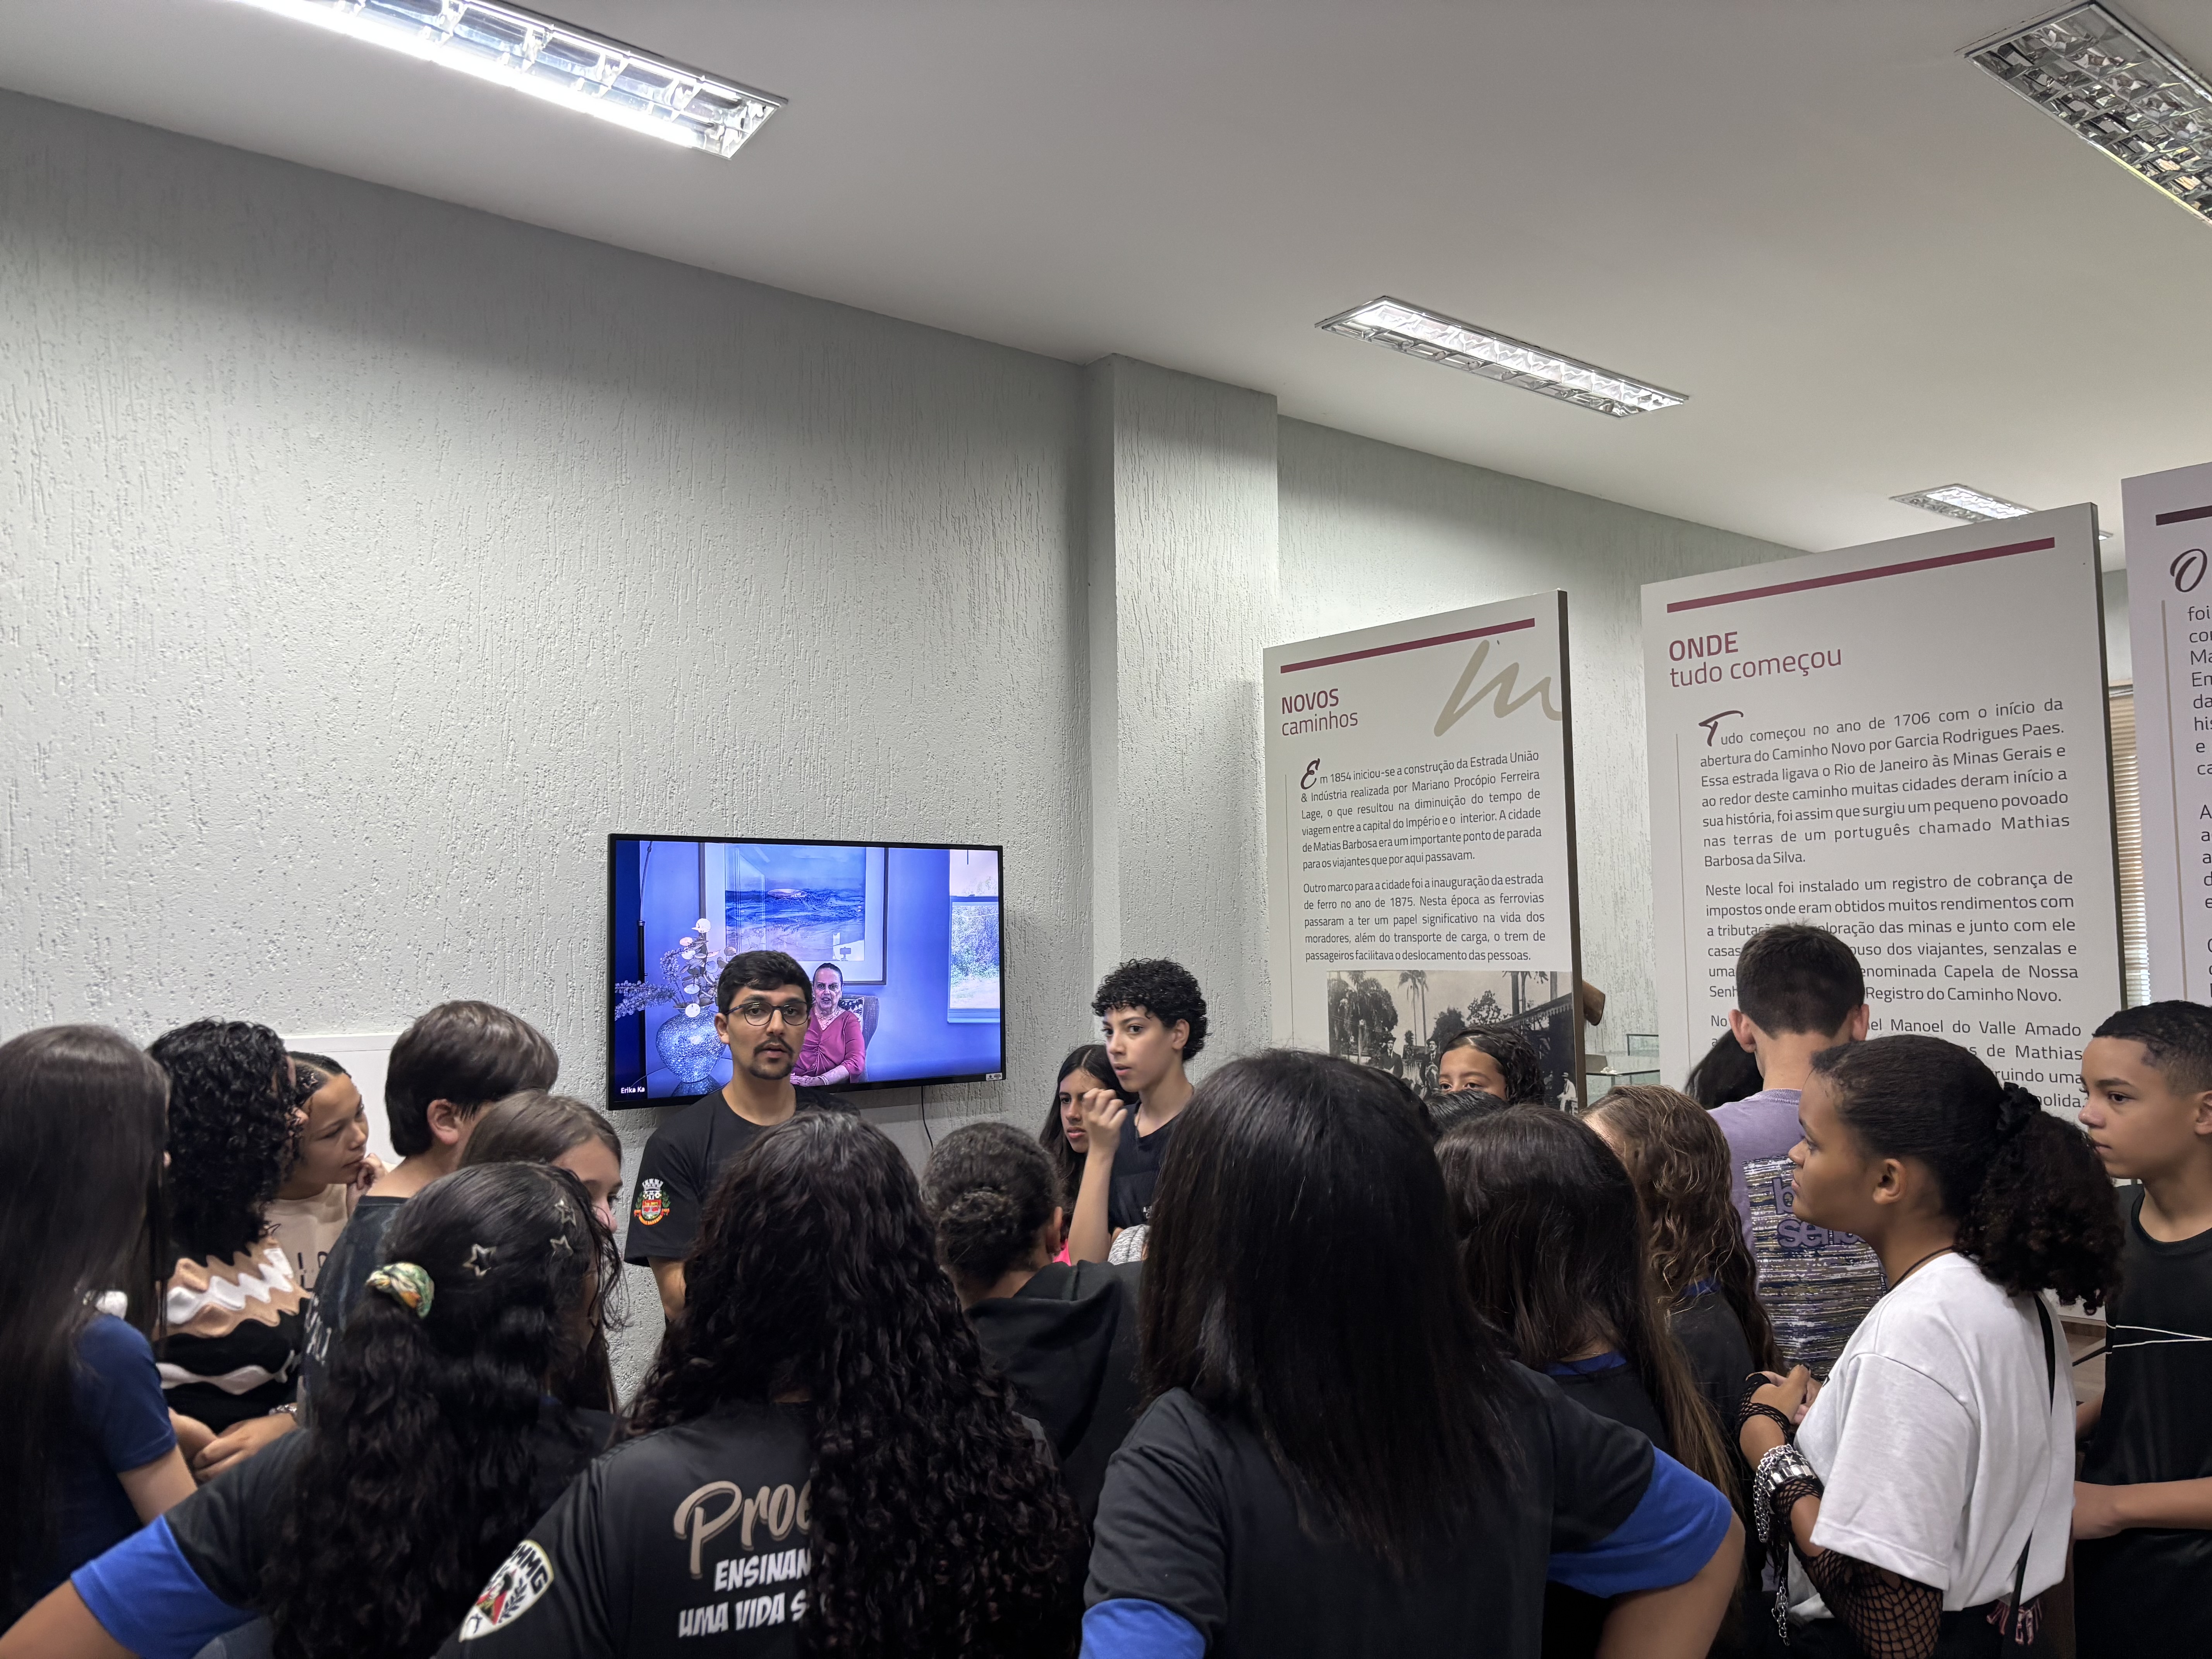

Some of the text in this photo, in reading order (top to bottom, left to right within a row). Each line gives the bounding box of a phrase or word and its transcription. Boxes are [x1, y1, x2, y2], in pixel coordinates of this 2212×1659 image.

[1669, 631, 1738, 661] ONDE
[1669, 649, 1841, 687] tudo começou
[1282, 688, 1339, 714] NOVOS
[1282, 711, 1358, 736] caminhos
[1750, 727, 1805, 742] começou
[1813, 725, 1829, 735] no
[1836, 721, 1861, 733] ano
[1869, 716, 1885, 730] de
[1894, 711, 1930, 726] 1706
[1938, 710, 1969, 722] com
[1978, 708, 1987, 718] o
[1996, 701, 2035, 716] início
[2044, 697, 2063, 711] da
[1700, 723, 2064, 767] abertura do Caminho Novo por Garcia Rodrigues Paes.
[2196, 742, 2205, 753] e
[1330, 771, 1352, 783] 1854
[1353, 768, 1395, 780] iniciou-se
[1403, 760, 1454, 775] construção
[1456, 757, 1468, 769] da
[1470, 753, 1508, 767] Estrada
[1510, 750, 1539, 763] União
[1300, 769, 1540, 802] & Indústria realizada por Mariano Procópio Ferreira
[1702, 768, 2068, 807] ao redor deste caminho muitas cidades deram início a
[1301, 809, 1322, 821] Lage,
[1337, 807, 1353, 819] que
[1357, 802, 1393, 814] resultou
[1398, 802, 1410, 811] na
[1414, 795, 1465, 809] diminuição
[1471, 793, 1483, 804] do
[1489, 792, 1522, 804] tempo
[1527, 788, 1540, 799] de
[1704, 814, 2069, 847] nas terras de um português chamado Mathias
[1704, 851, 1805, 867] Barbosa da Silva.
[1705, 870, 2073, 896] Neste local foi instalado um registro de cobrança de
[1304, 891, 1544, 910] de ferro no ano de 1875. Nesta época as ferrovias
[1706, 896, 2074, 919] impostos onde eram obtidos muitos rendimentos com
[1304, 918, 1344, 929] passaram
[1357, 915, 1370, 925] ter
[1374, 917, 1388, 925] um
[1393, 913, 1417, 927] papel
[1422, 912, 1478, 927] significativo
[1483, 914, 1495, 923] na
[1500, 911, 1521, 922] vida
[1526, 910, 1545, 922] dos
[1879, 917, 2075, 935] das minas e junto com ele
[1305, 929, 1545, 945] moradores, além do transporte de carga, o trem de
[1887, 941, 2077, 958] dos viajantes, senzalas e
[1305, 949, 1531, 963] passageiros facilitava o deslocamento das pessoas.
[1707, 947, 1741, 957] casas
[1866, 986, 2061, 1003] Registro do Caminho Novo.
[1891, 1018, 2081, 1036] Manoel do Valle Amado
[678, 1602, 728, 1638] UMA
[735, 1592, 785, 1631] VIDA
